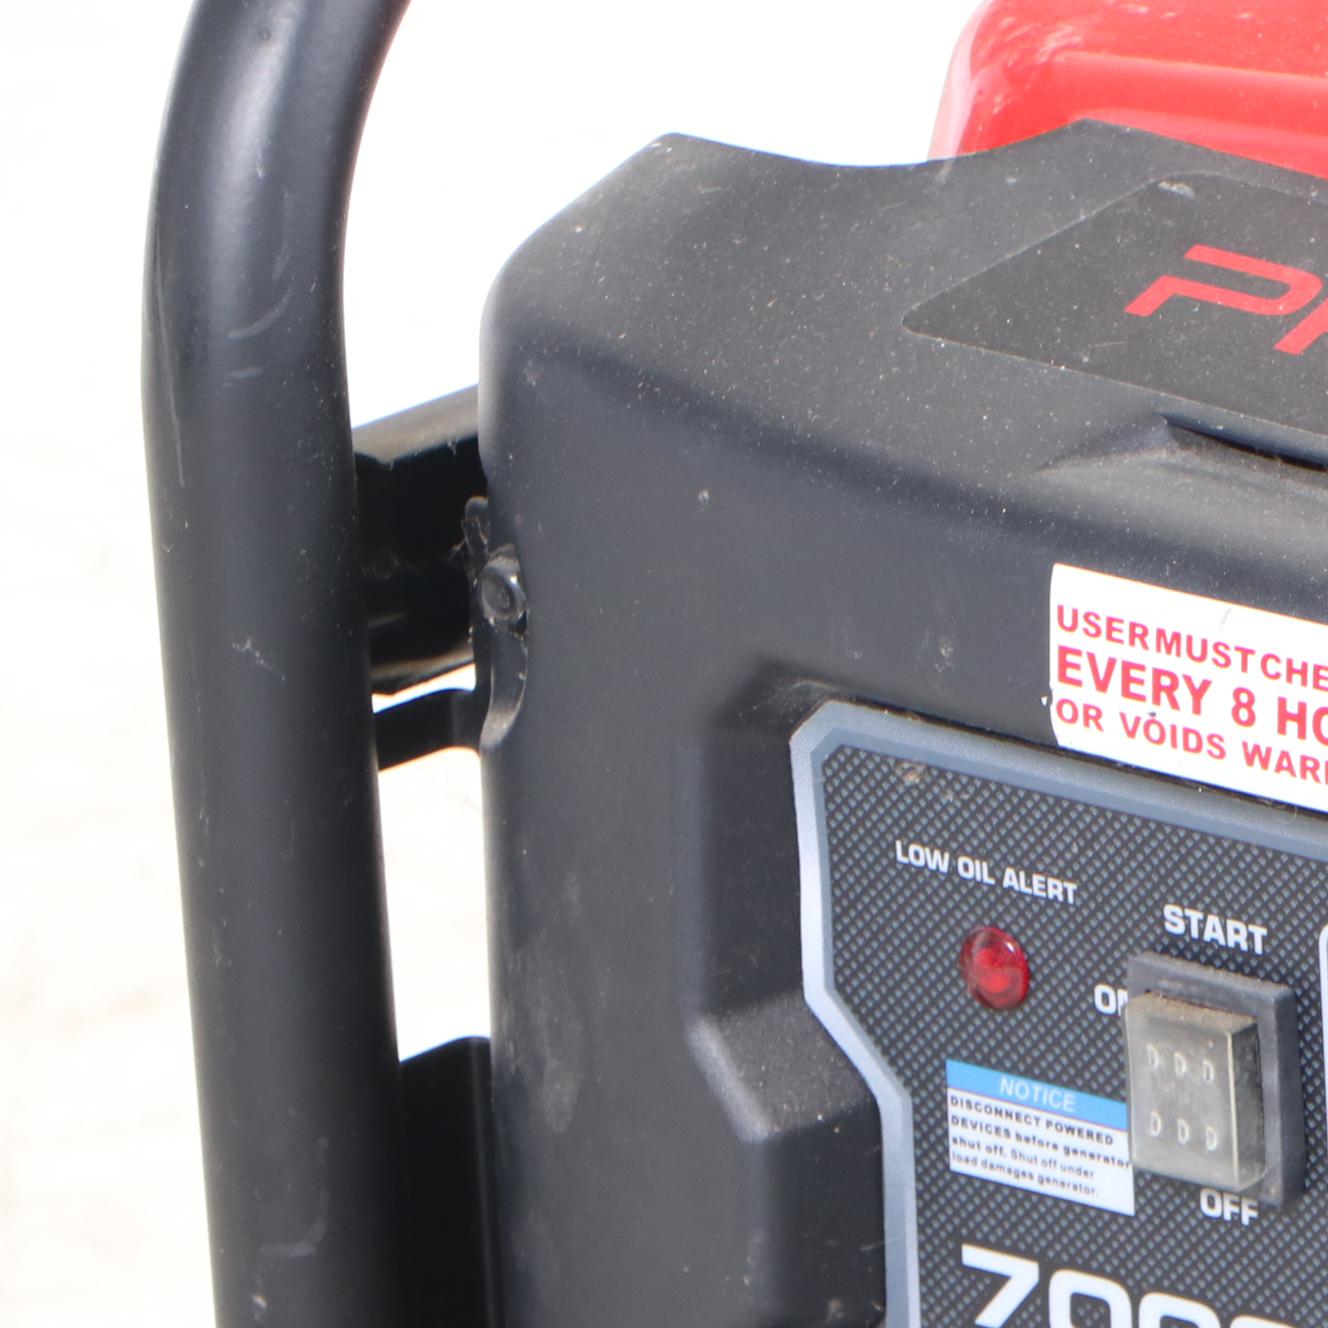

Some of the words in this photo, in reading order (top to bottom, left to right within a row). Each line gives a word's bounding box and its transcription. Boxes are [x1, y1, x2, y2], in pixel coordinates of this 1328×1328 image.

[1057, 604, 1149, 649] USER
[1155, 628, 1255, 674] MUST
[1057, 645, 1211, 715] EVERY
[1231, 687, 1256, 727] 8
[1055, 699, 1104, 731] OR
[1119, 712, 1226, 759] VOIDS
[896, 840, 949, 873] LOW
[957, 856, 995, 885] OIL
[1003, 867, 1077, 904] ALERT
[1163, 904, 1268, 955] START
[1000, 1076, 1077, 1112] NOTICE
[950, 1096, 1041, 1127] DISCONNECT
[1046, 1120, 1113, 1145] POWERED
[951, 1115, 1011, 1138] DEVICES
[1015, 1131, 1058, 1151] before
[1064, 1146, 1131, 1169] generator
[952, 1136, 981, 1151] shut
[1011, 1150, 1038, 1165] Shut
[1041, 1155, 1057, 1170] off
[1060, 1163, 1094, 1179] under
[952, 1151, 977, 1166] load
[981, 1160, 1034, 1180] damages
[1200, 1189, 1258, 1225] OFF
